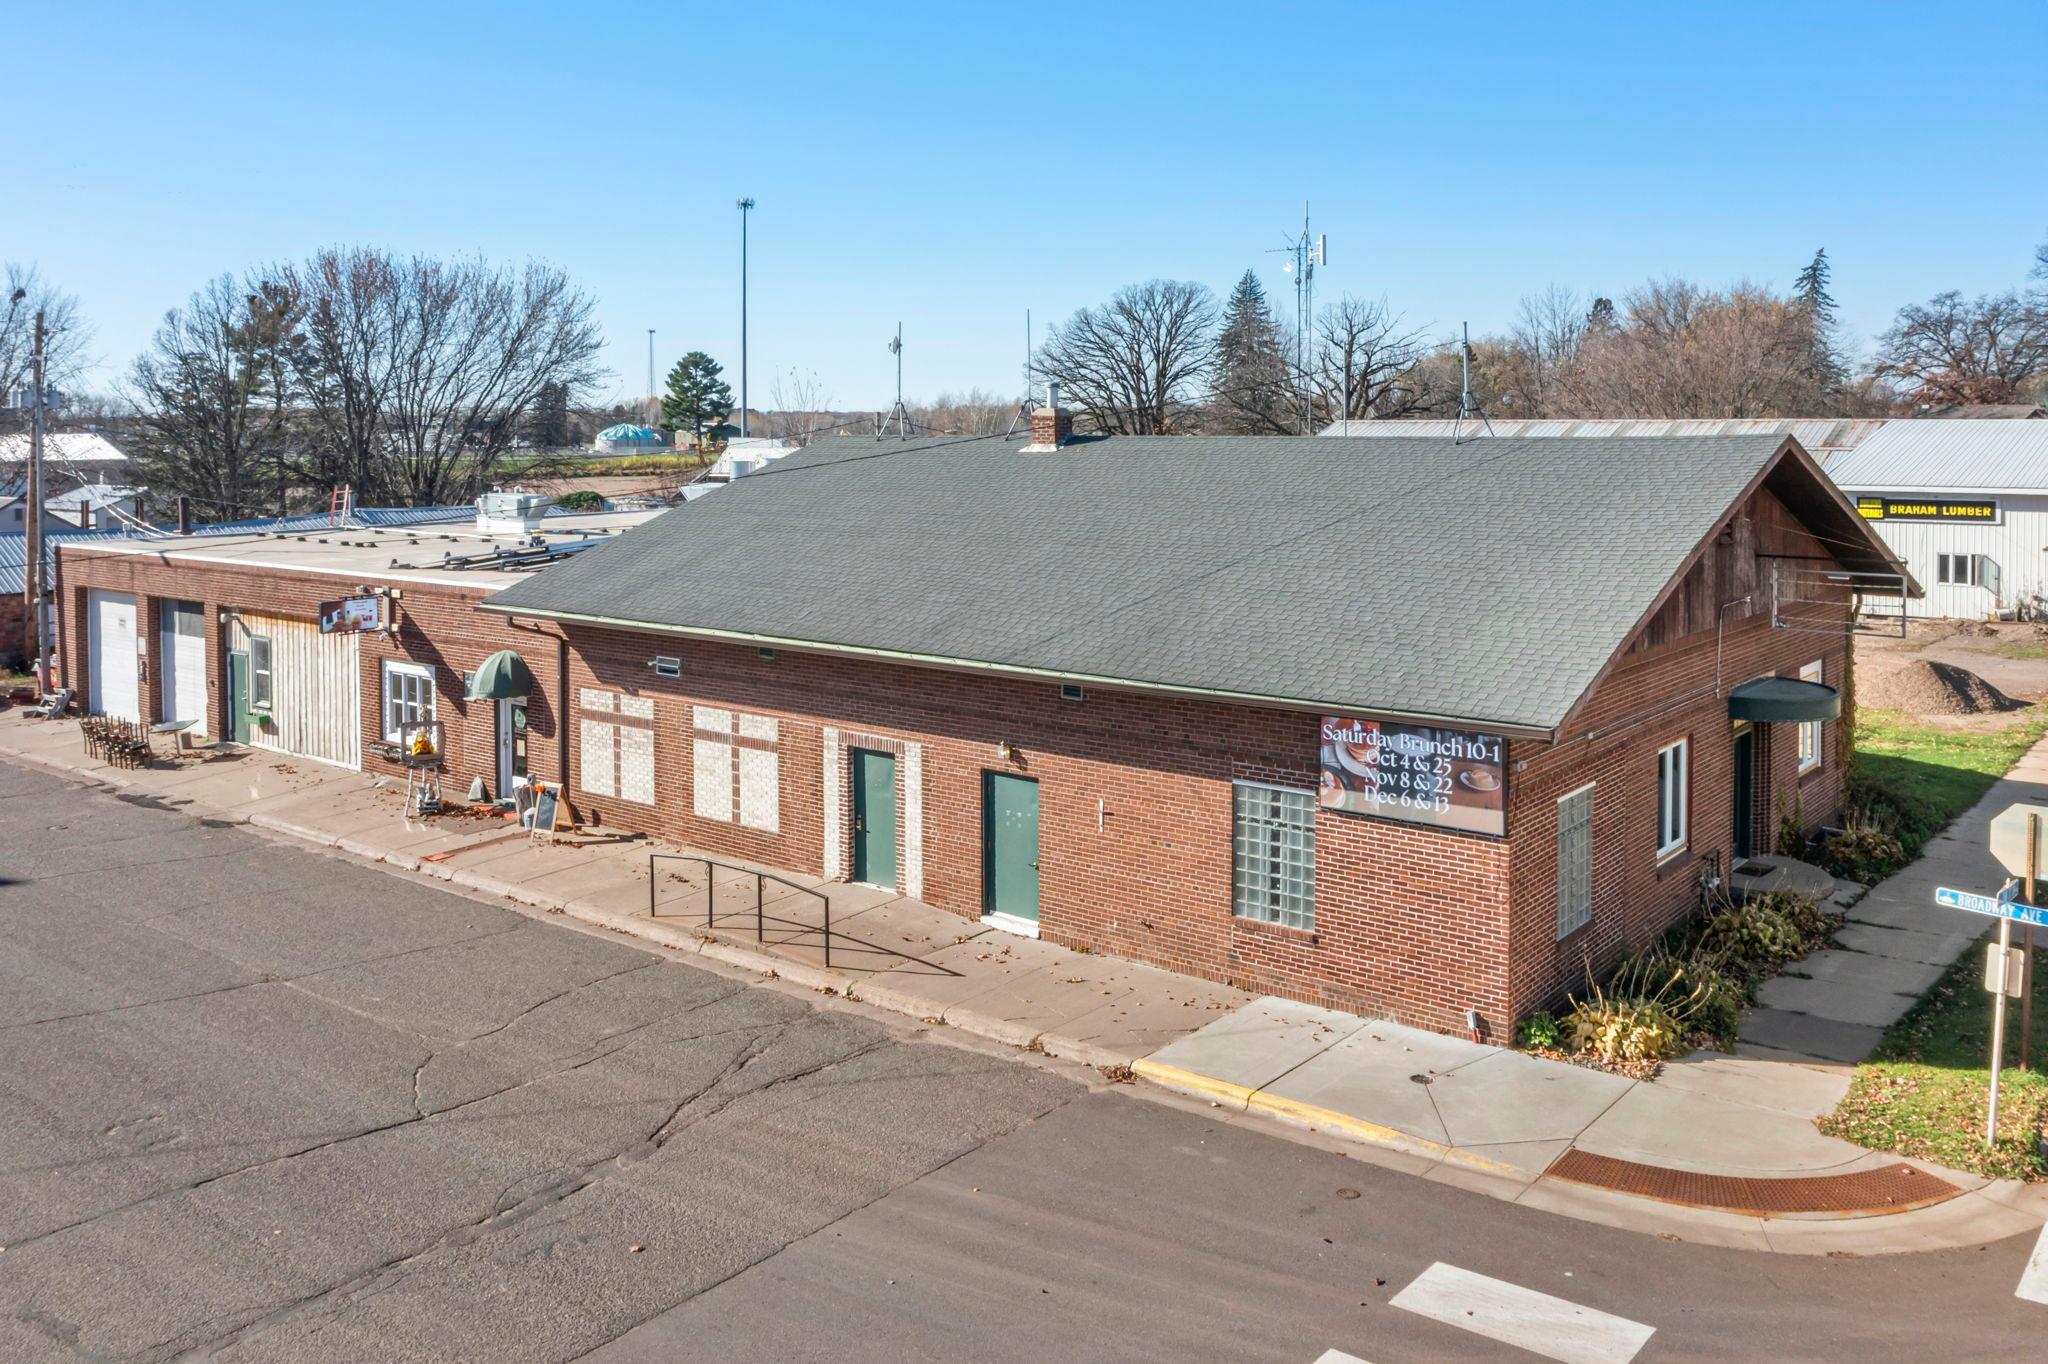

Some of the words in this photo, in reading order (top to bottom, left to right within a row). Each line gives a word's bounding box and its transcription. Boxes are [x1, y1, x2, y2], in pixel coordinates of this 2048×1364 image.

[1890, 505, 1937, 515] BRAHAM
[1942, 506, 1991, 516] LUMBER
[1323, 724, 1393, 751] Saturday
[1400, 733, 1462, 757] Brunch
[1467, 742, 1500, 762] 10-1
[1366, 750, 1398, 767] Oct
[1400, 754, 1410, 770] 4
[1413, 755, 1430, 771] &
[1433, 757, 1452, 775] 25
[1365, 767, 1397, 786] Nov
[1400, 771, 1410, 787] 8
[1413, 774, 1430, 791] &
[1433, 776, 1453, 794] 22
[1364, 785, 1397, 805] Dec
[1400, 790, 1411, 807] 6
[1414, 793, 1431, 810] &
[1434, 797, 1450, 815] 13
[1957, 895, 2015, 917] BROADWAY
[2020, 907, 2043, 923] AVE
